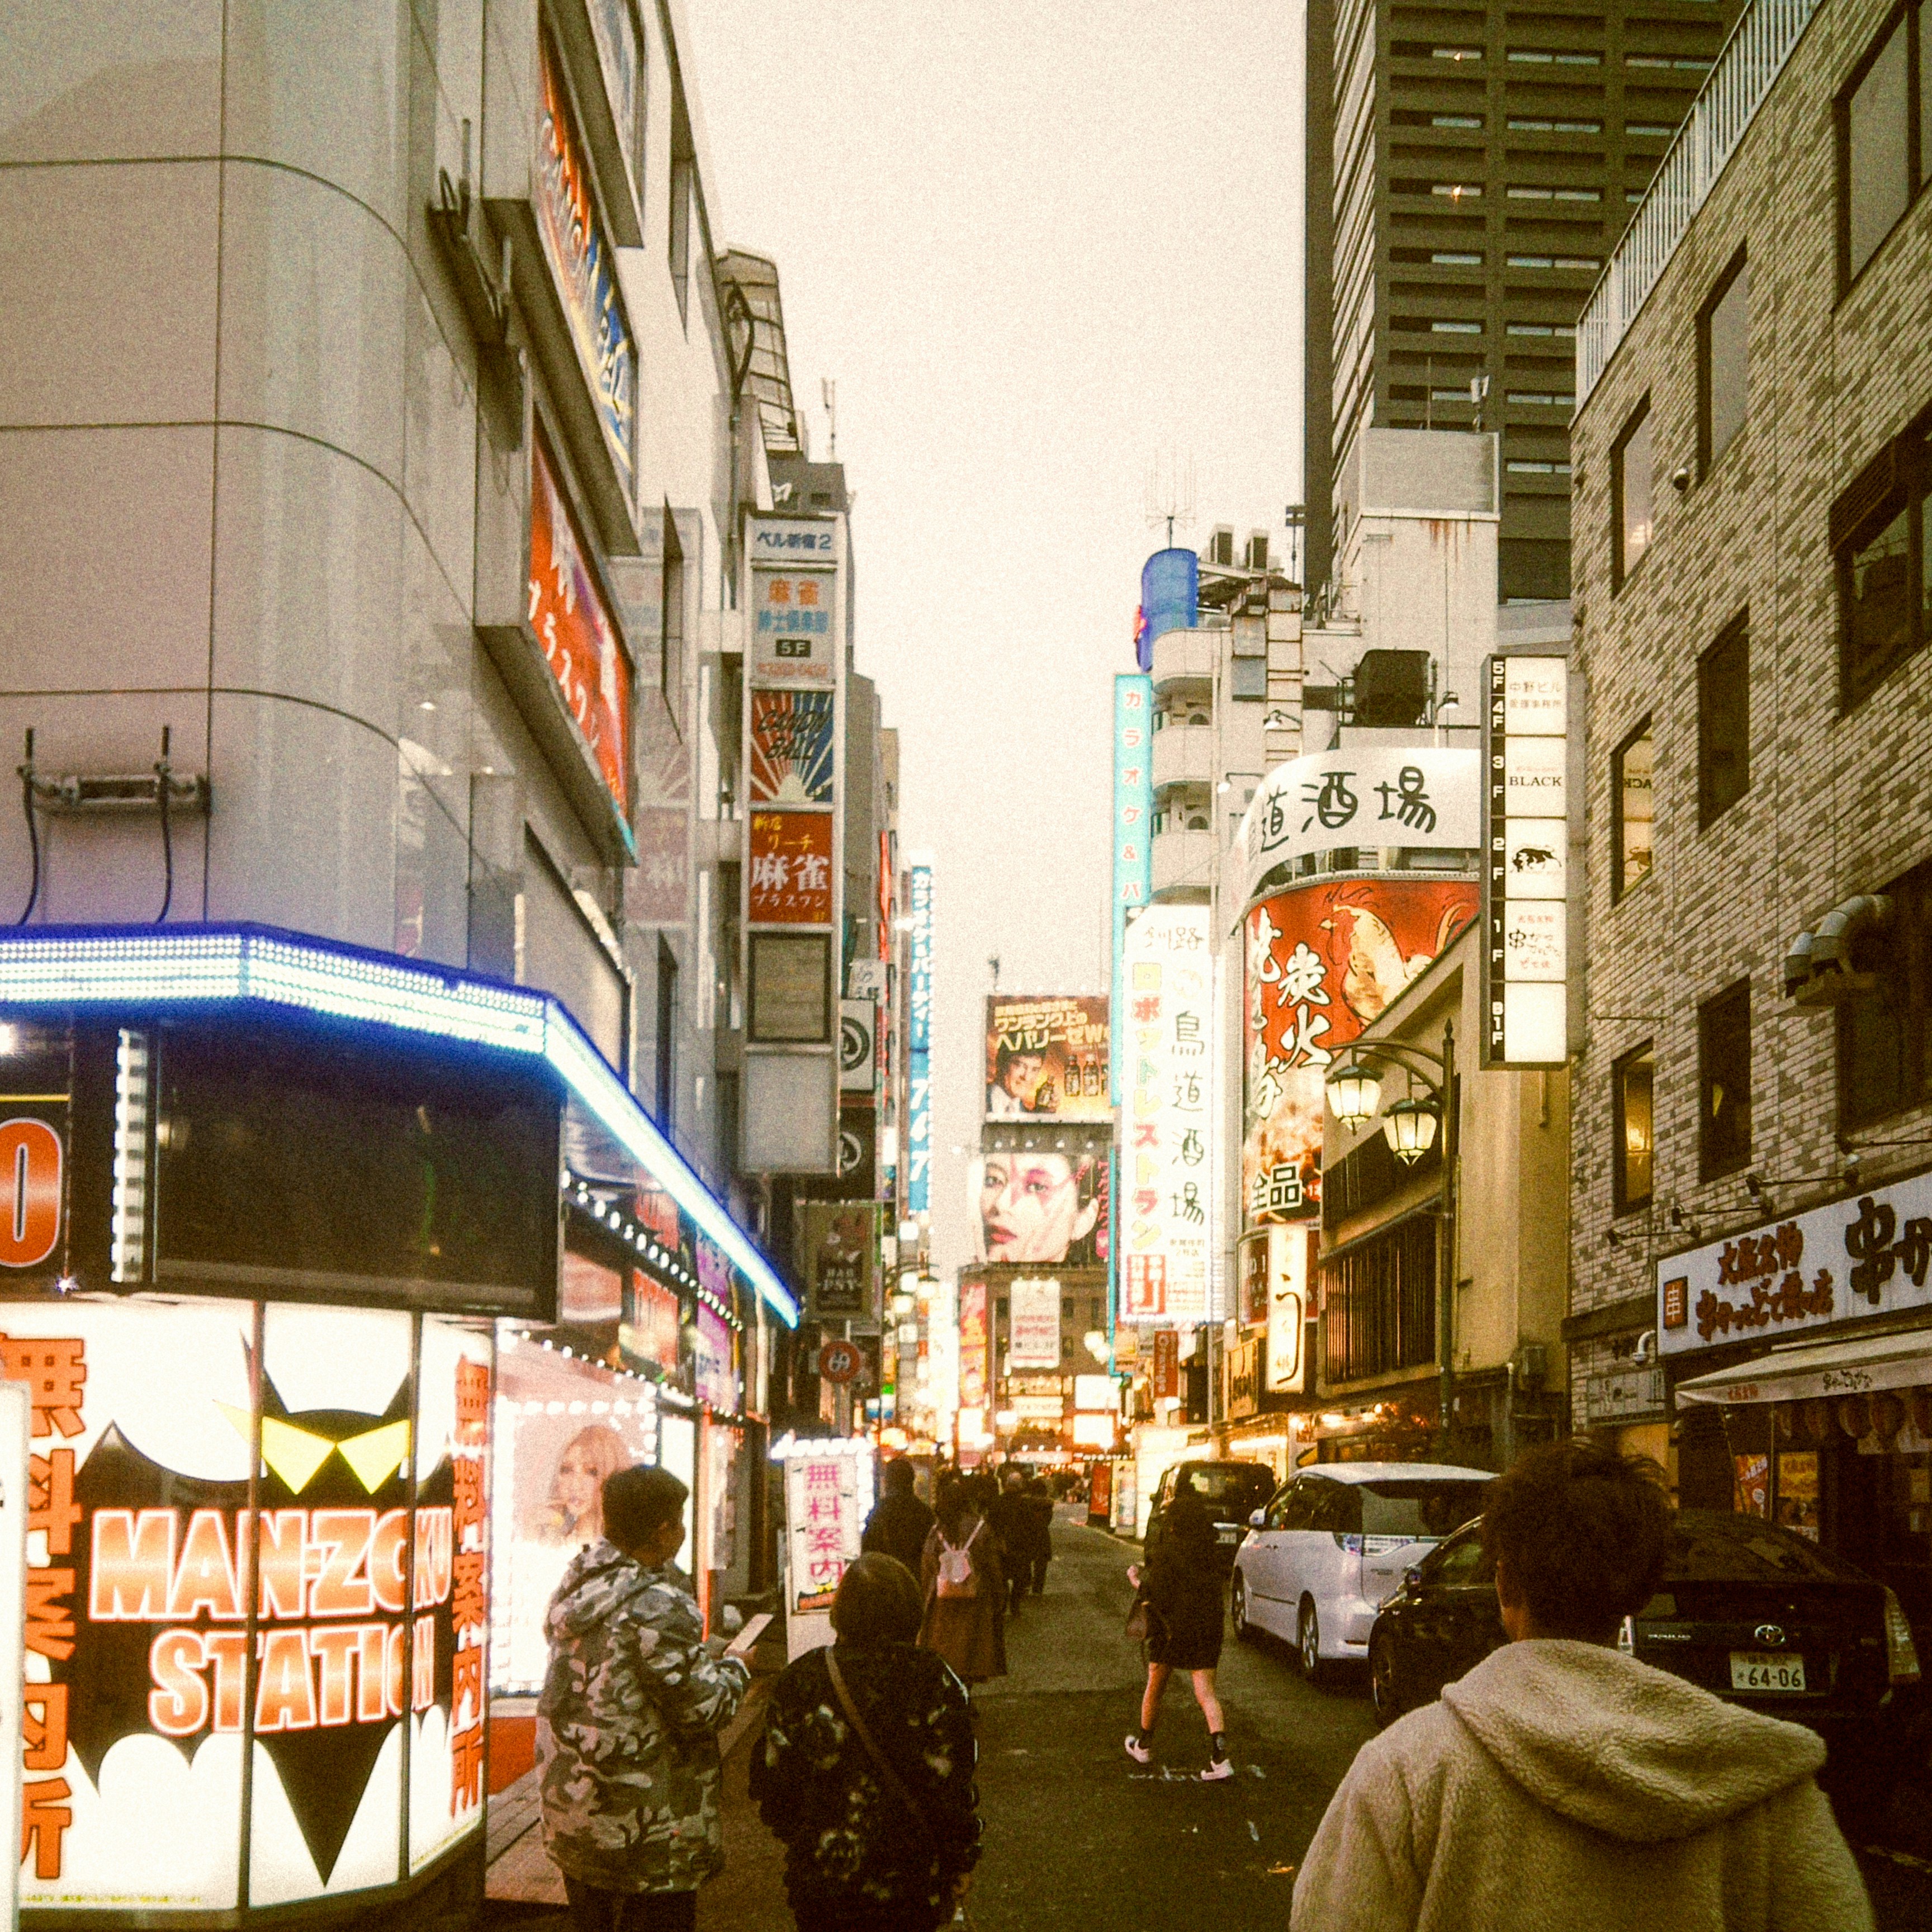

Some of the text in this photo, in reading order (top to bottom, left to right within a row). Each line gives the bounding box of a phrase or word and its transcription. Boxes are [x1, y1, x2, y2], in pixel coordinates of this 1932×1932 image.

[780, 642, 806, 655] 5F
[1492, 661, 1505, 690] 5F
[1492, 701, 1505, 728] 4F
[1492, 756, 1505, 799] 3F
[1509, 775, 1562, 787] BLACK
[768, 834, 815, 851] リーチ
[750, 851, 830, 892] 麻雀
[1492, 837, 1505, 881] 2F
[1491, 1000, 1505, 1046] B1F
[148, 1616, 435, 1736] STATION
[1748, 1667, 1801, 1688] 64-06
